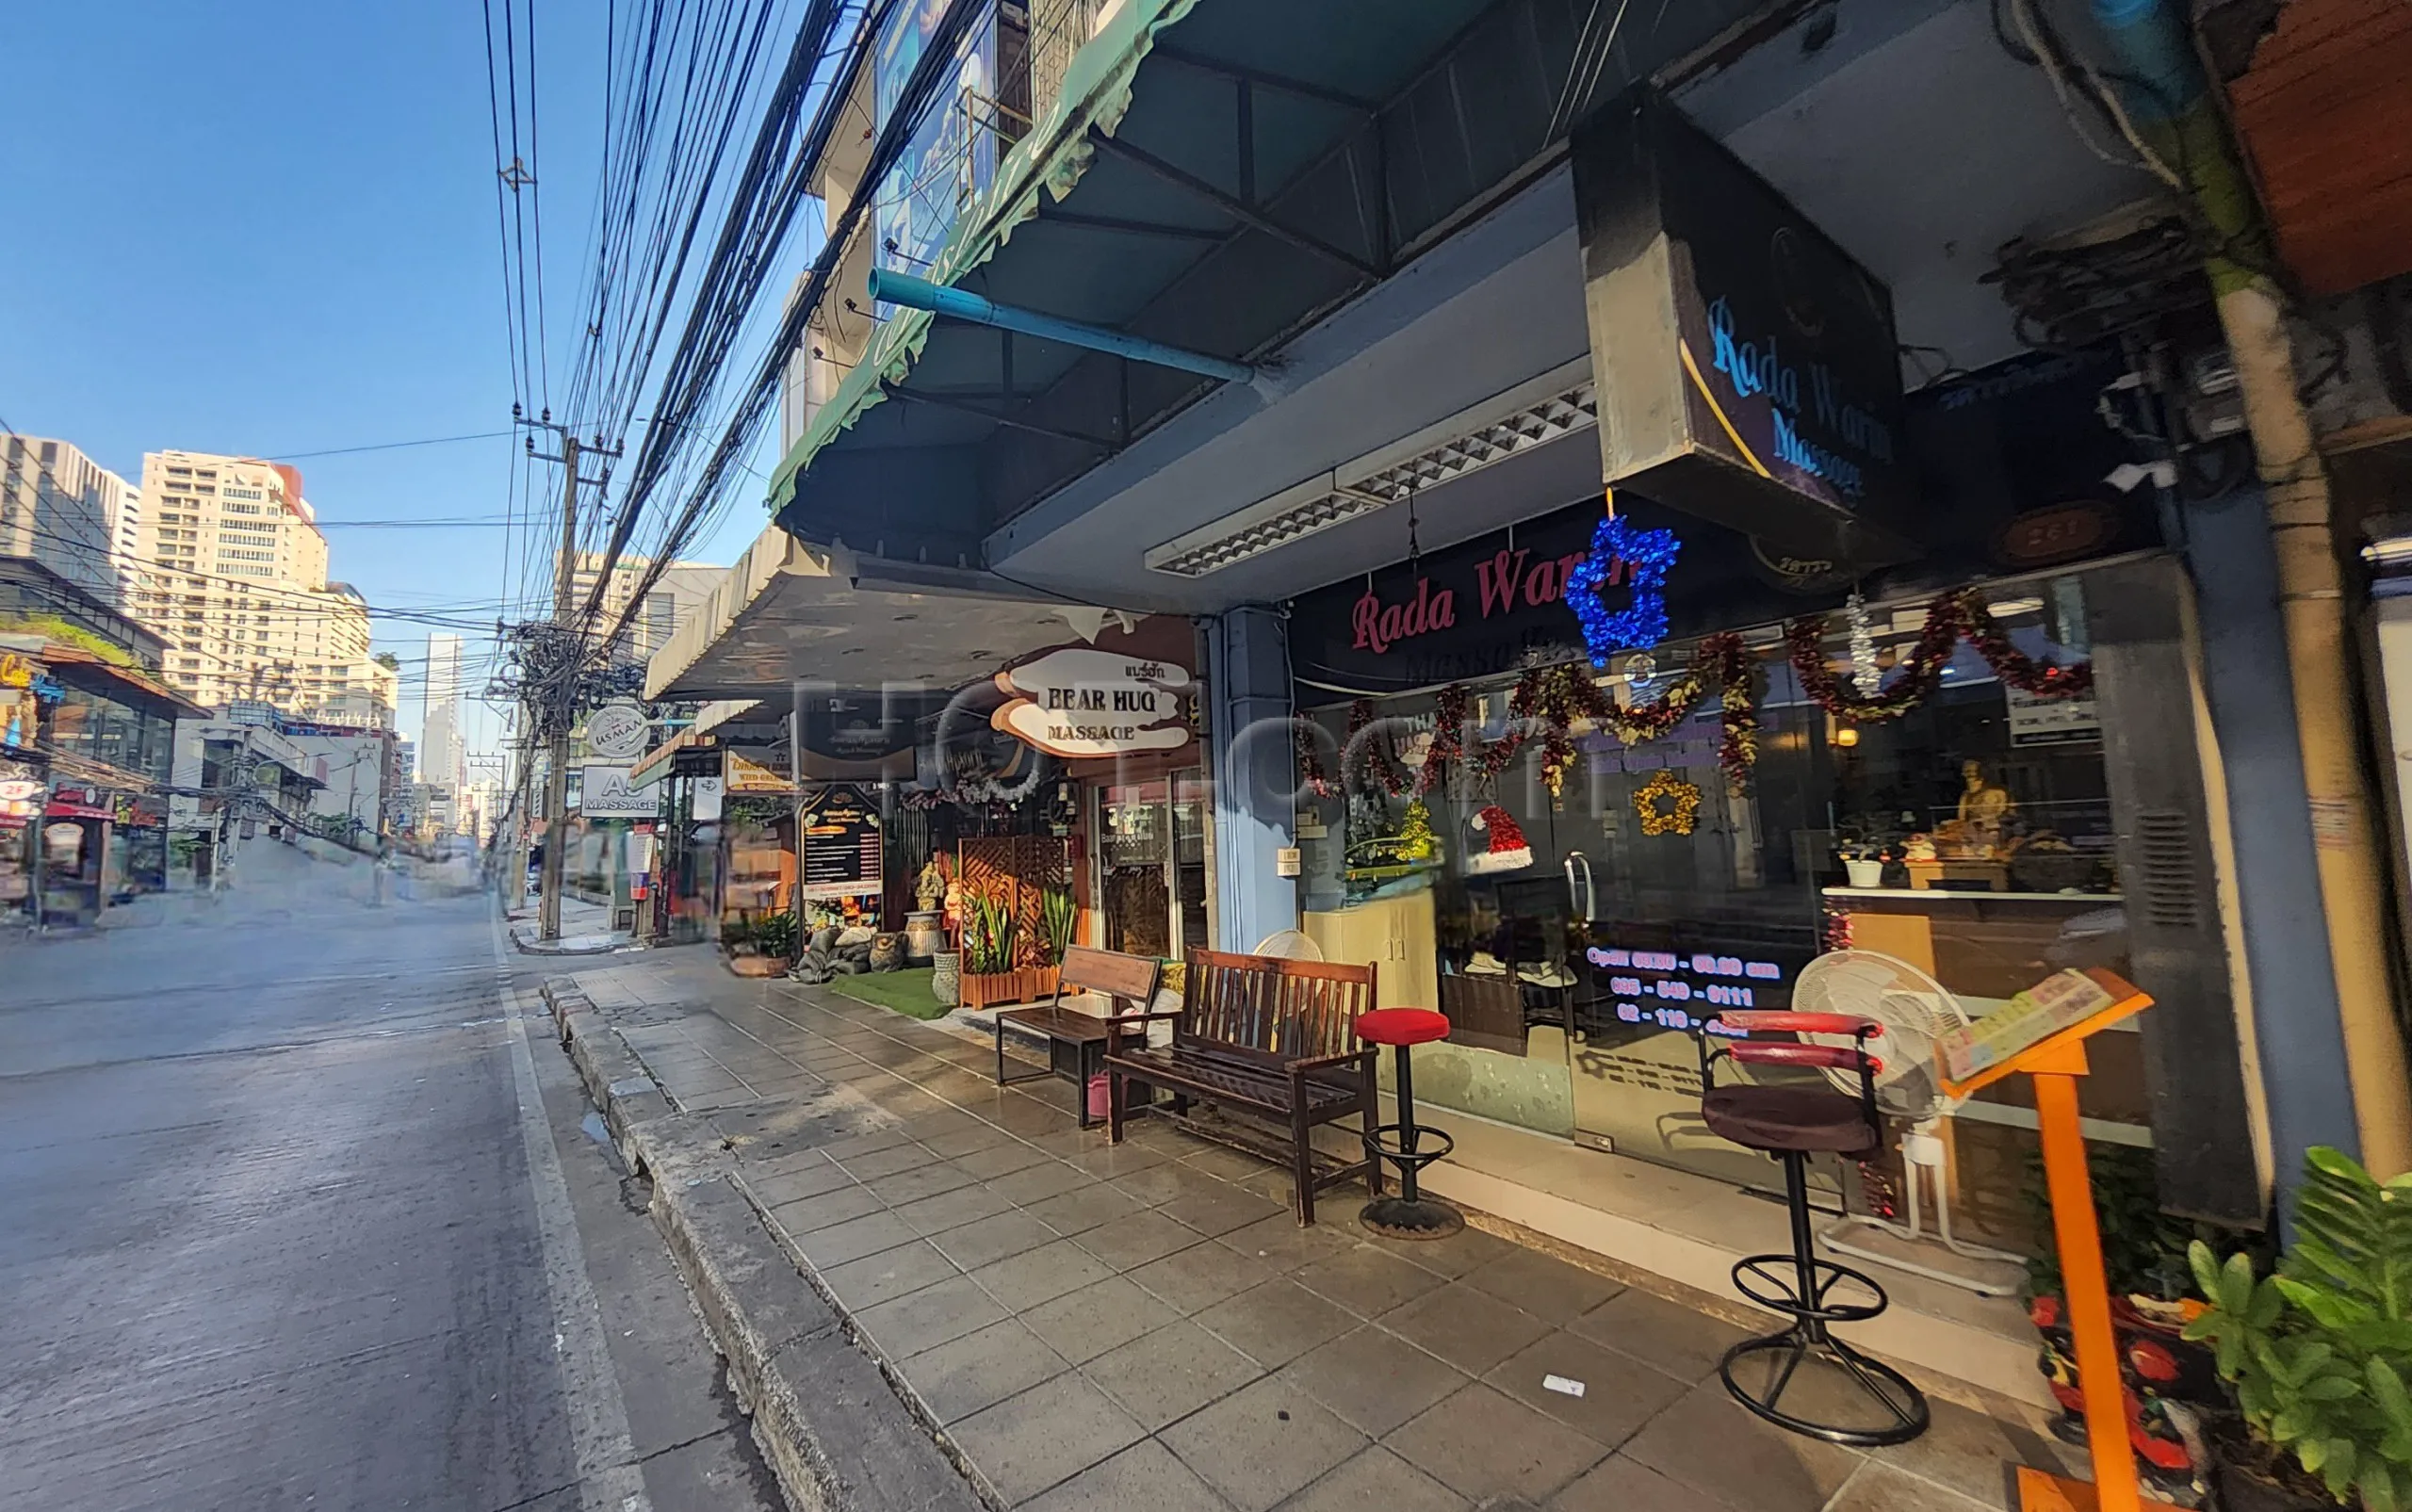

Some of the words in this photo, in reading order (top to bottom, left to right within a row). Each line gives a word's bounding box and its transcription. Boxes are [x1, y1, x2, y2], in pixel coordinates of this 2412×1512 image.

[1351, 577, 1455, 654] Rada
[1048, 688, 1106, 711] BEAR
[595, 717, 643, 746] USMAN
[1048, 724, 1135, 740] MASSAGE
[601, 773, 643, 798] A
[585, 798, 657, 811] MASSAGE
[1587, 947, 1630, 967] Open
